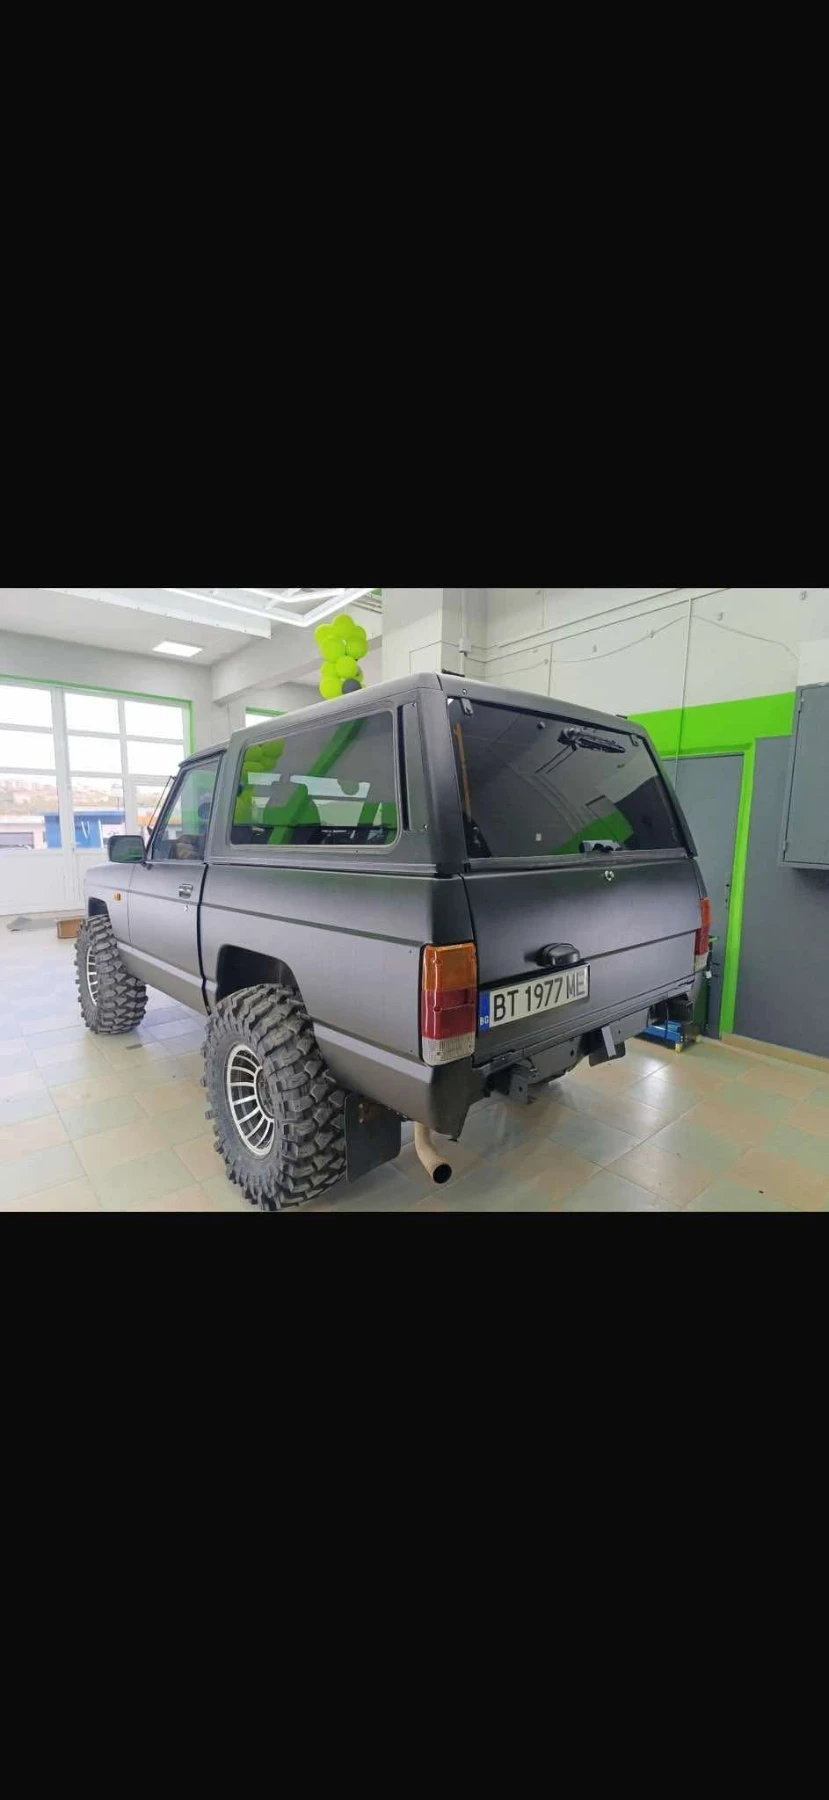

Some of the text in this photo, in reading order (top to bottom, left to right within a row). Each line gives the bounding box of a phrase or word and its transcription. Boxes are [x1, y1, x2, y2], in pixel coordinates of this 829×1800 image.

[493, 971, 586, 1022] BT 1977 ME
[479, 1015, 489, 1026] BG
